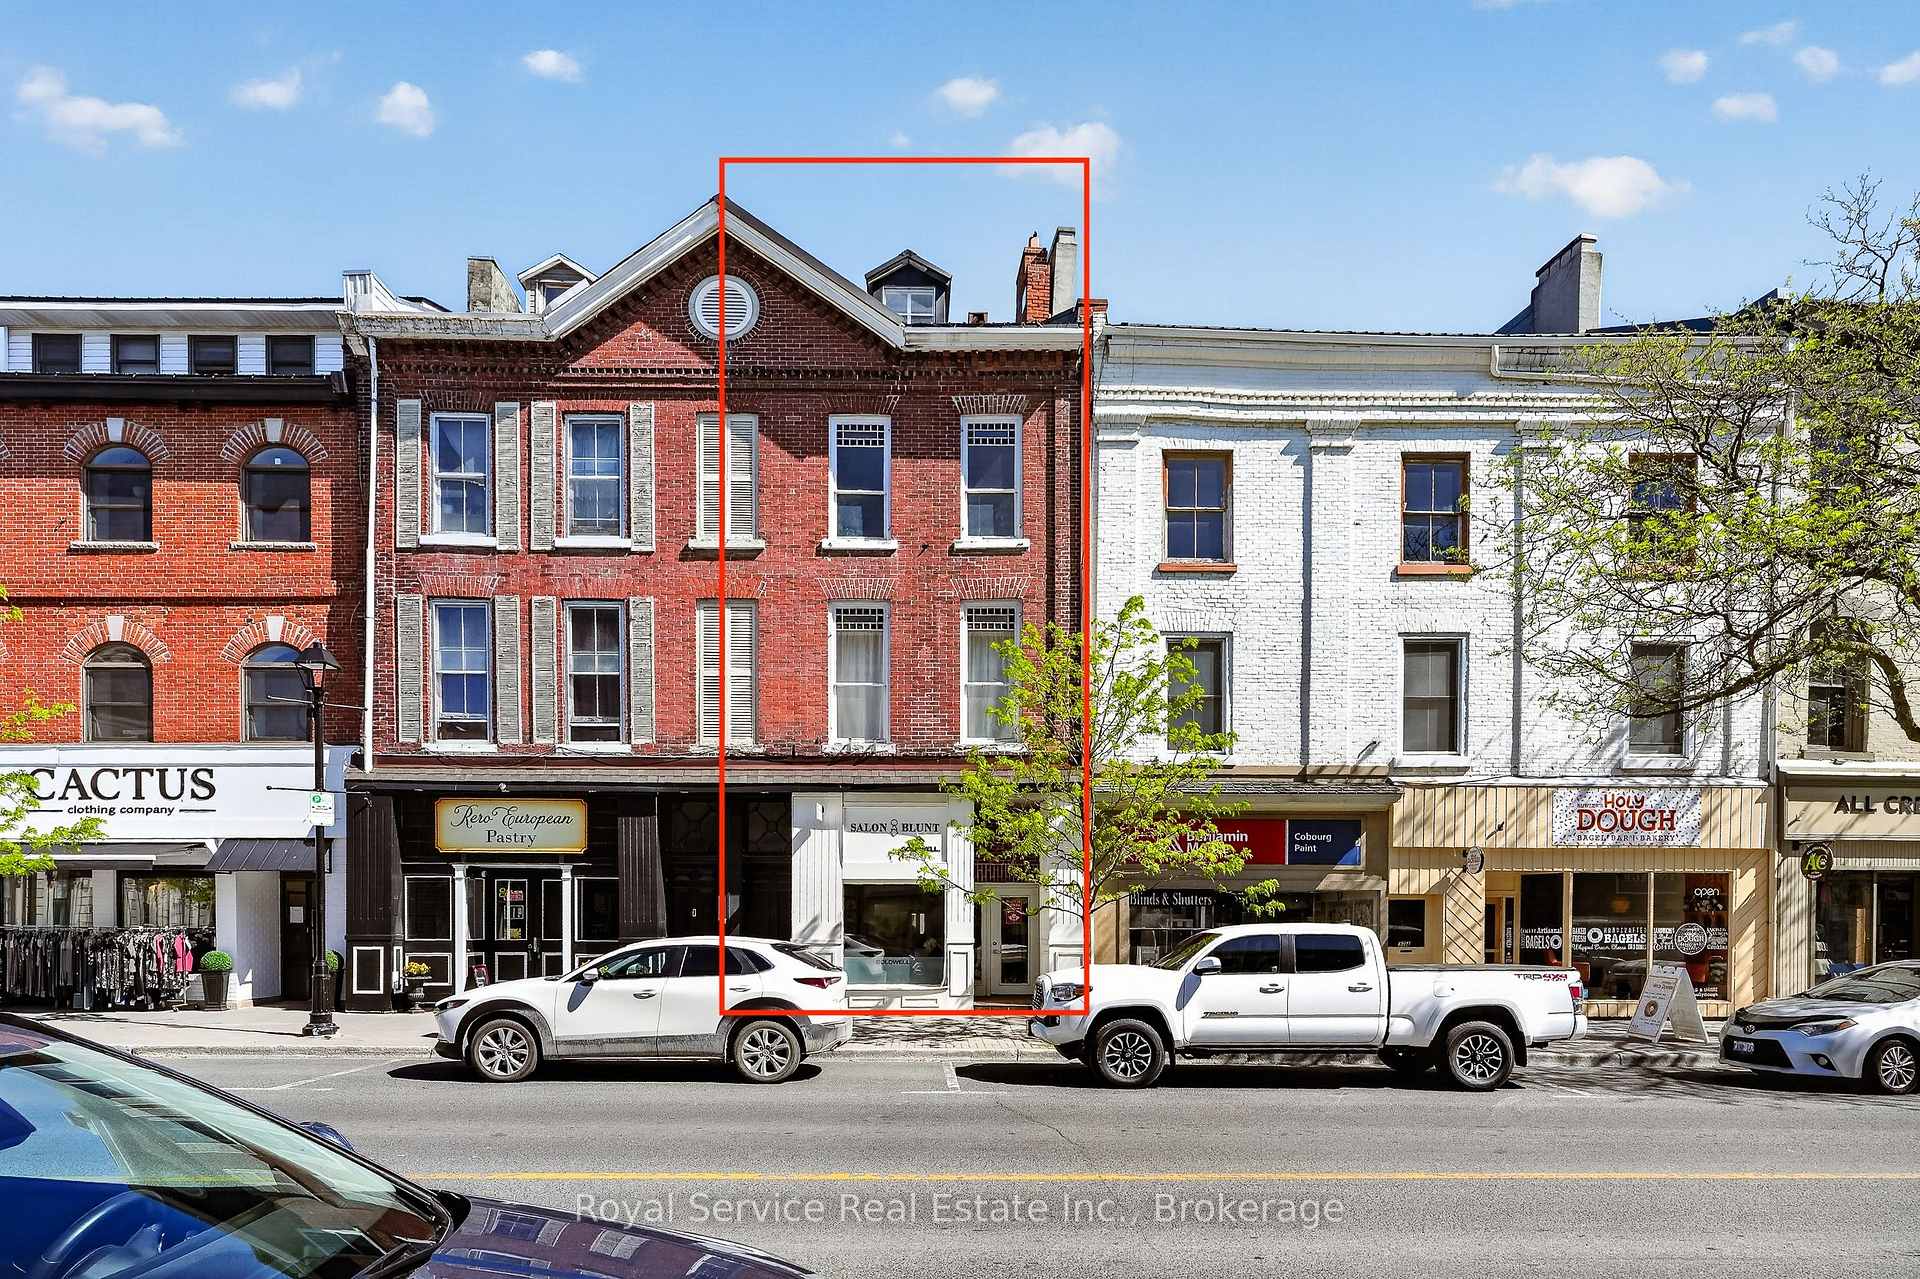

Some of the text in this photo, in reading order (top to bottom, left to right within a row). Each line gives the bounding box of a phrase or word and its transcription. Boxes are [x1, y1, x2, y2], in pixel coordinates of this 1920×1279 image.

[29, 768, 216, 801] CACTUS
[1604, 793, 1645, 809] HOLY
[1834, 795, 1877, 815] ALL
[67, 805, 175, 816] clothing company
[492, 806, 574, 830] European
[1576, 809, 1677, 832] DOUGH
[850, 823, 940, 832] SALON BLUNT
[486, 829, 537, 847] Pastry
[1294, 832, 1332, 842] Cobourg
[1577, 834, 1606, 842] BAGEL
[1641, 834, 1675, 842] BAKERY
[1294, 844, 1317, 852] Paint
[1129, 891, 1212, 906] Blinds & Shutters
[1694, 887, 1720, 897] open
[1525, 935, 1550, 949] BAGELS
[1604, 934, 1647, 943] BAGELS
